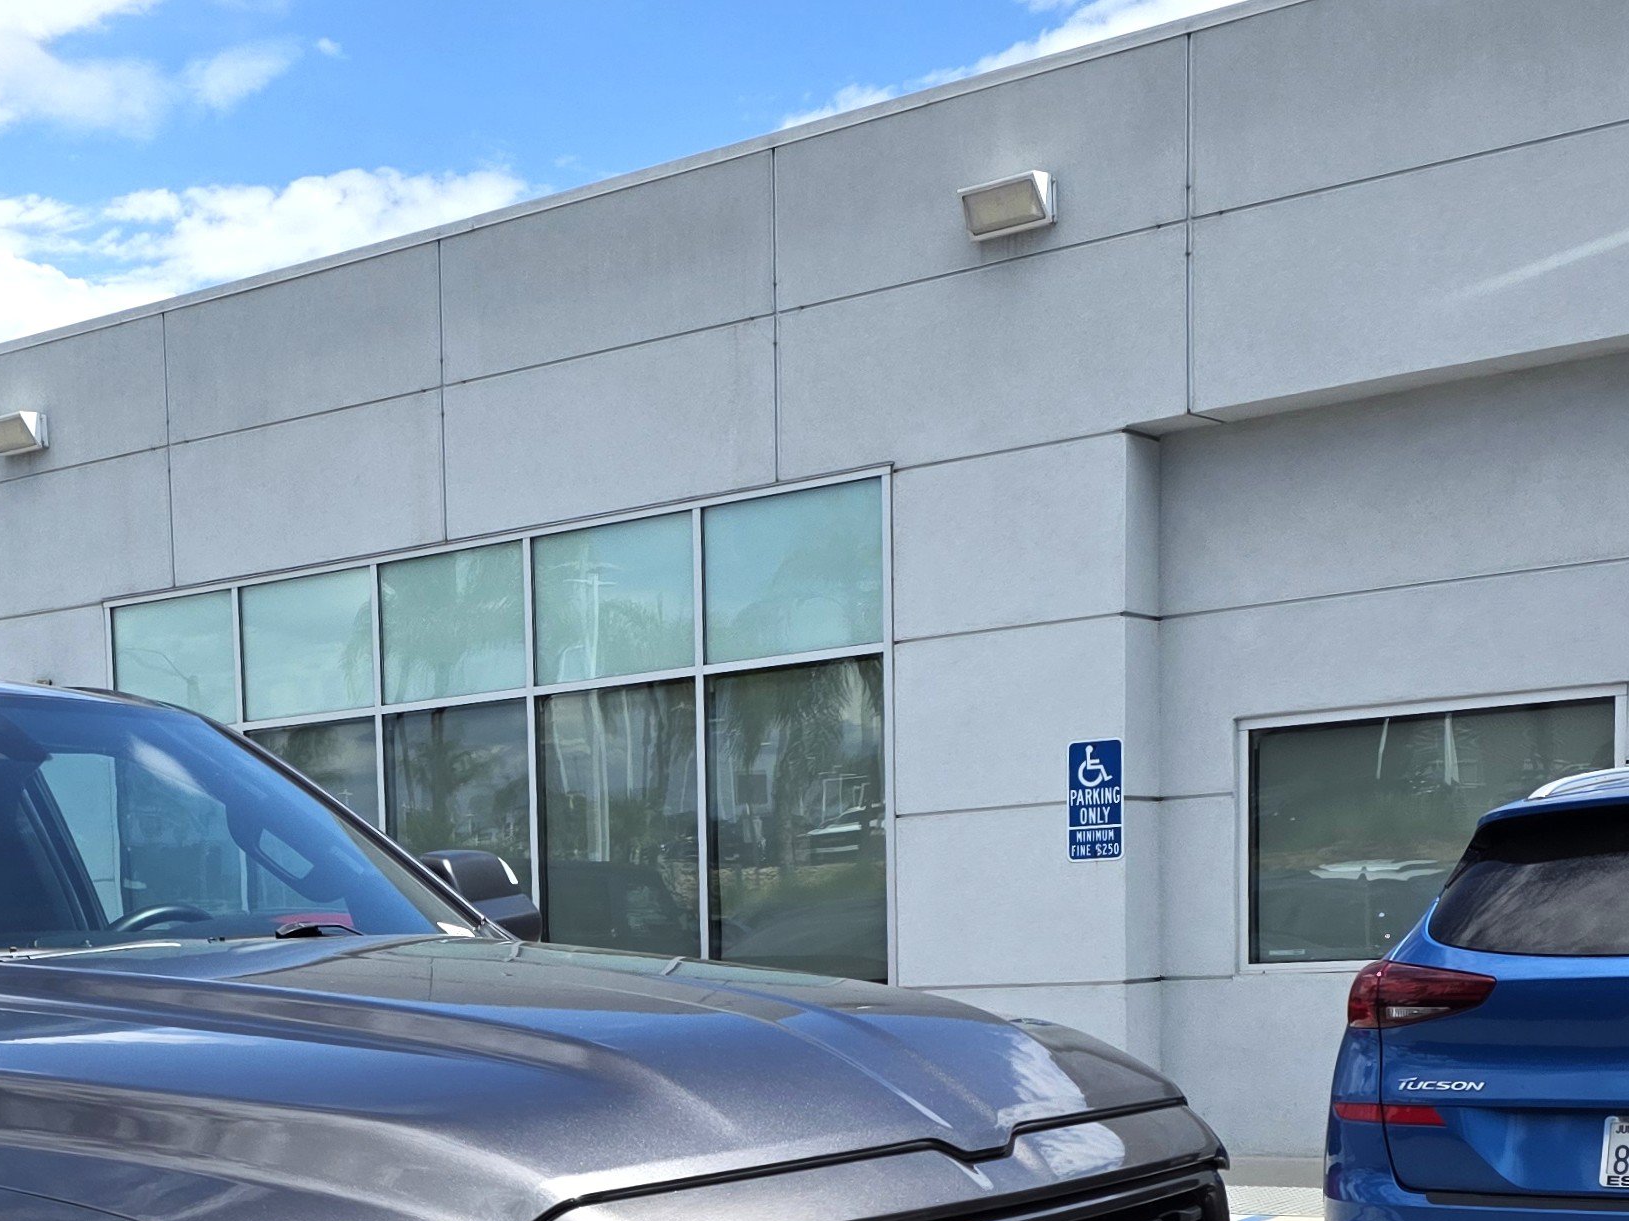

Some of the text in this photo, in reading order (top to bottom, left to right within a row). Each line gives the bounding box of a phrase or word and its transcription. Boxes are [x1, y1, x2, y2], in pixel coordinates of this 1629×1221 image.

[1070, 786, 1120, 806] PARKING
[1080, 806, 1111, 825] ONLY
[1076, 829, 1114, 843] MINIMUM
[1071, 843, 1119, 857] FINE $250
[1398, 1077, 1485, 1092] TUCSON
[1615, 1124, 1629, 1134] JU
